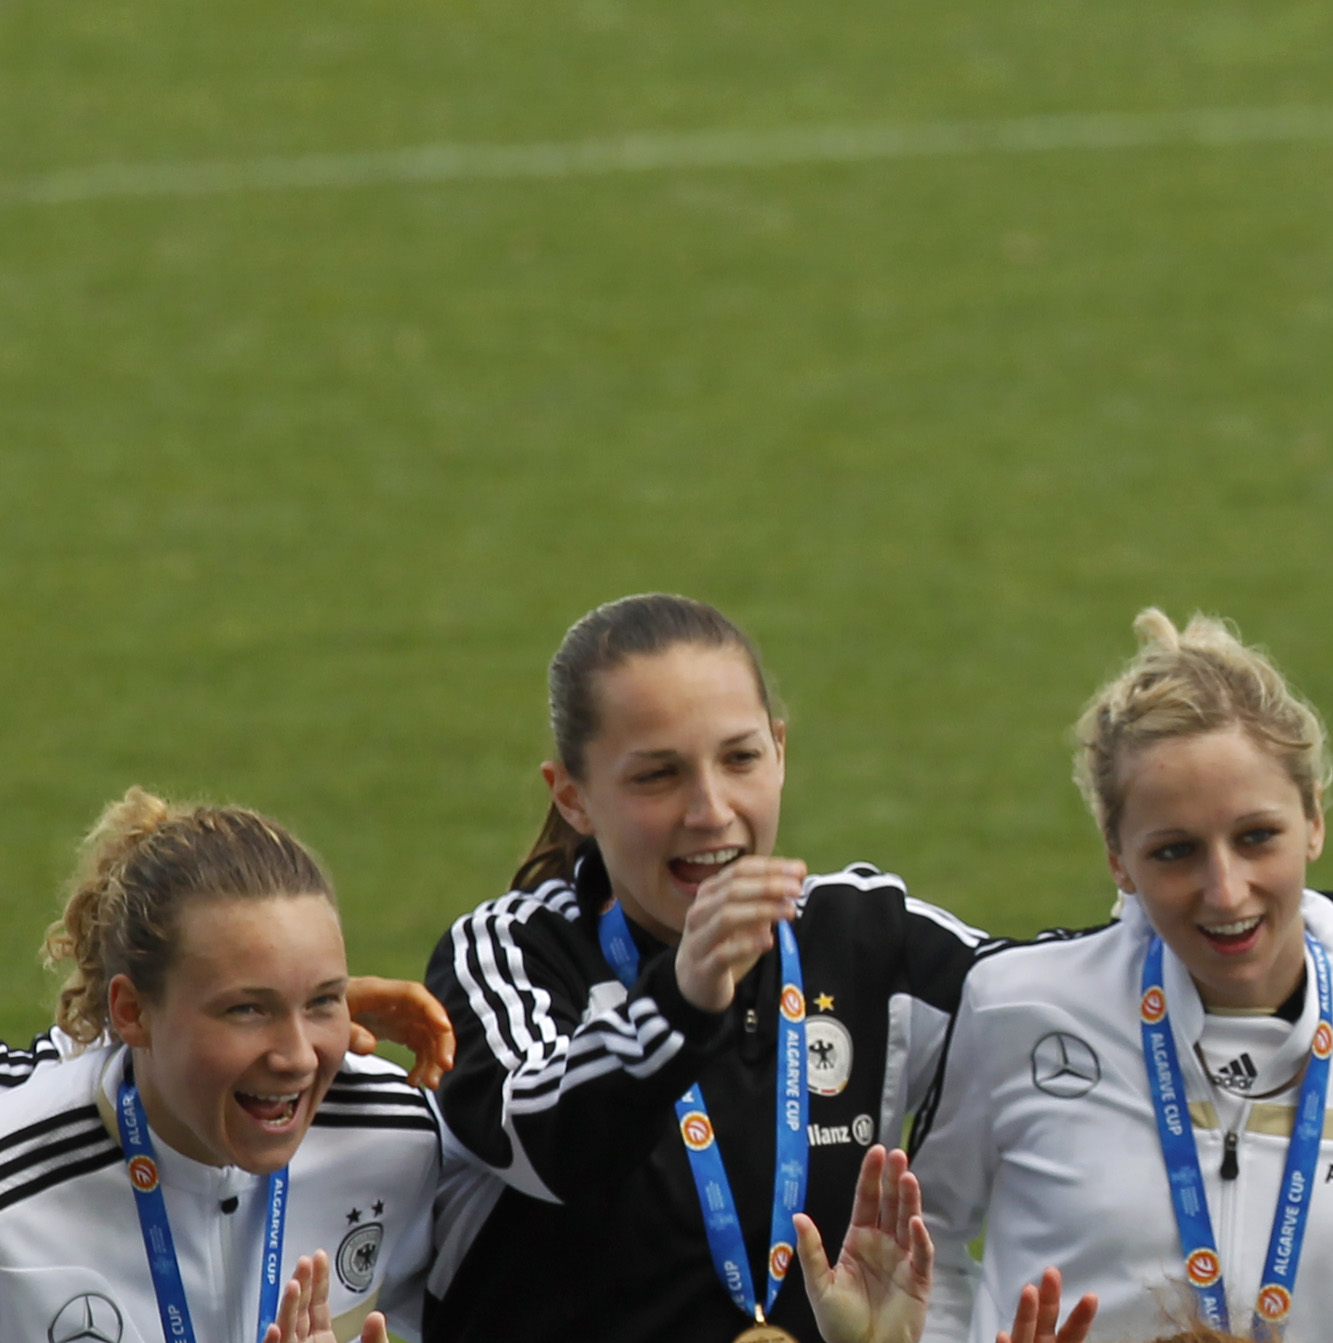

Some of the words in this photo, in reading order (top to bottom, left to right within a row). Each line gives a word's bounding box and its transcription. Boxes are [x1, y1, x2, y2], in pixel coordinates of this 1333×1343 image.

[786, 1029, 800, 1097] ALGARVE
[1150, 1033, 1176, 1102] ALGARVE
[1164, 1104, 1183, 1136] CUP
[785, 1100, 799, 1131] CUP
[807, 1124, 851, 1146] llianz
[269, 1178, 284, 1249] ALGARVE
[1273, 1205, 1300, 1276] ALGARVE
[1289, 1171, 1306, 1203] CUP
[267, 1252, 278, 1285] CUP
[725, 1260, 742, 1291] CUP
[168, 1304, 185, 1336] CUP
